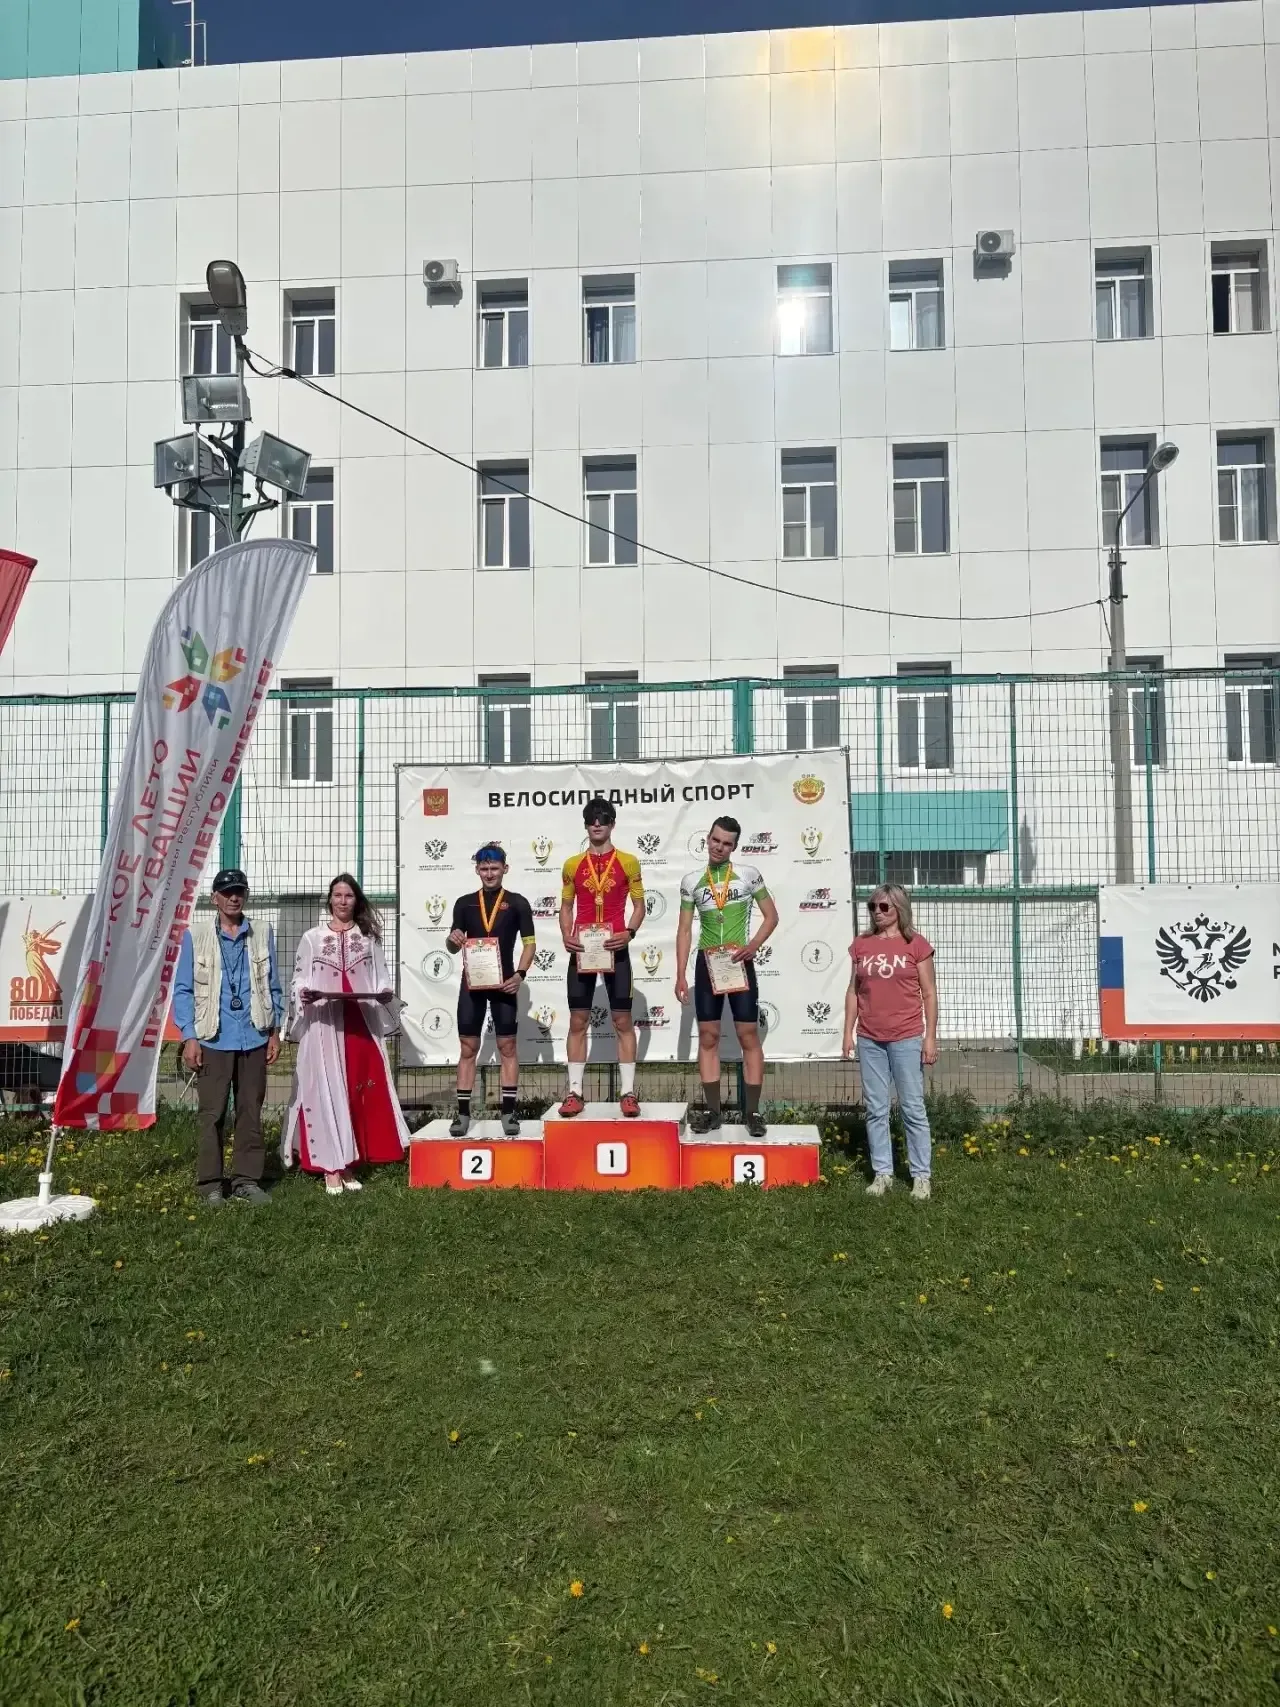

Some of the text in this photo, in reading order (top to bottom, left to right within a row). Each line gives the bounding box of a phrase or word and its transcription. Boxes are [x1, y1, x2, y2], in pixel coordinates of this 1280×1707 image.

[132, 739, 169, 836] ЛЕТО
[488, 783, 755, 808] ВЕЛОСИПЕДНЫЙ СПОРТ
[178, 758, 219, 844] Республики
[131, 748, 201, 929] ЧУВАШИИ
[141, 876, 199, 1048] ПРОВЕДЕМ
[188, 791, 227, 870] ЛЕТО
[10, 976, 39, 1001] 80
[10, 1006, 63, 1021] ПОБЕДА!
[470, 1155, 483, 1175] 2
[742, 1161, 756, 1182] 3
